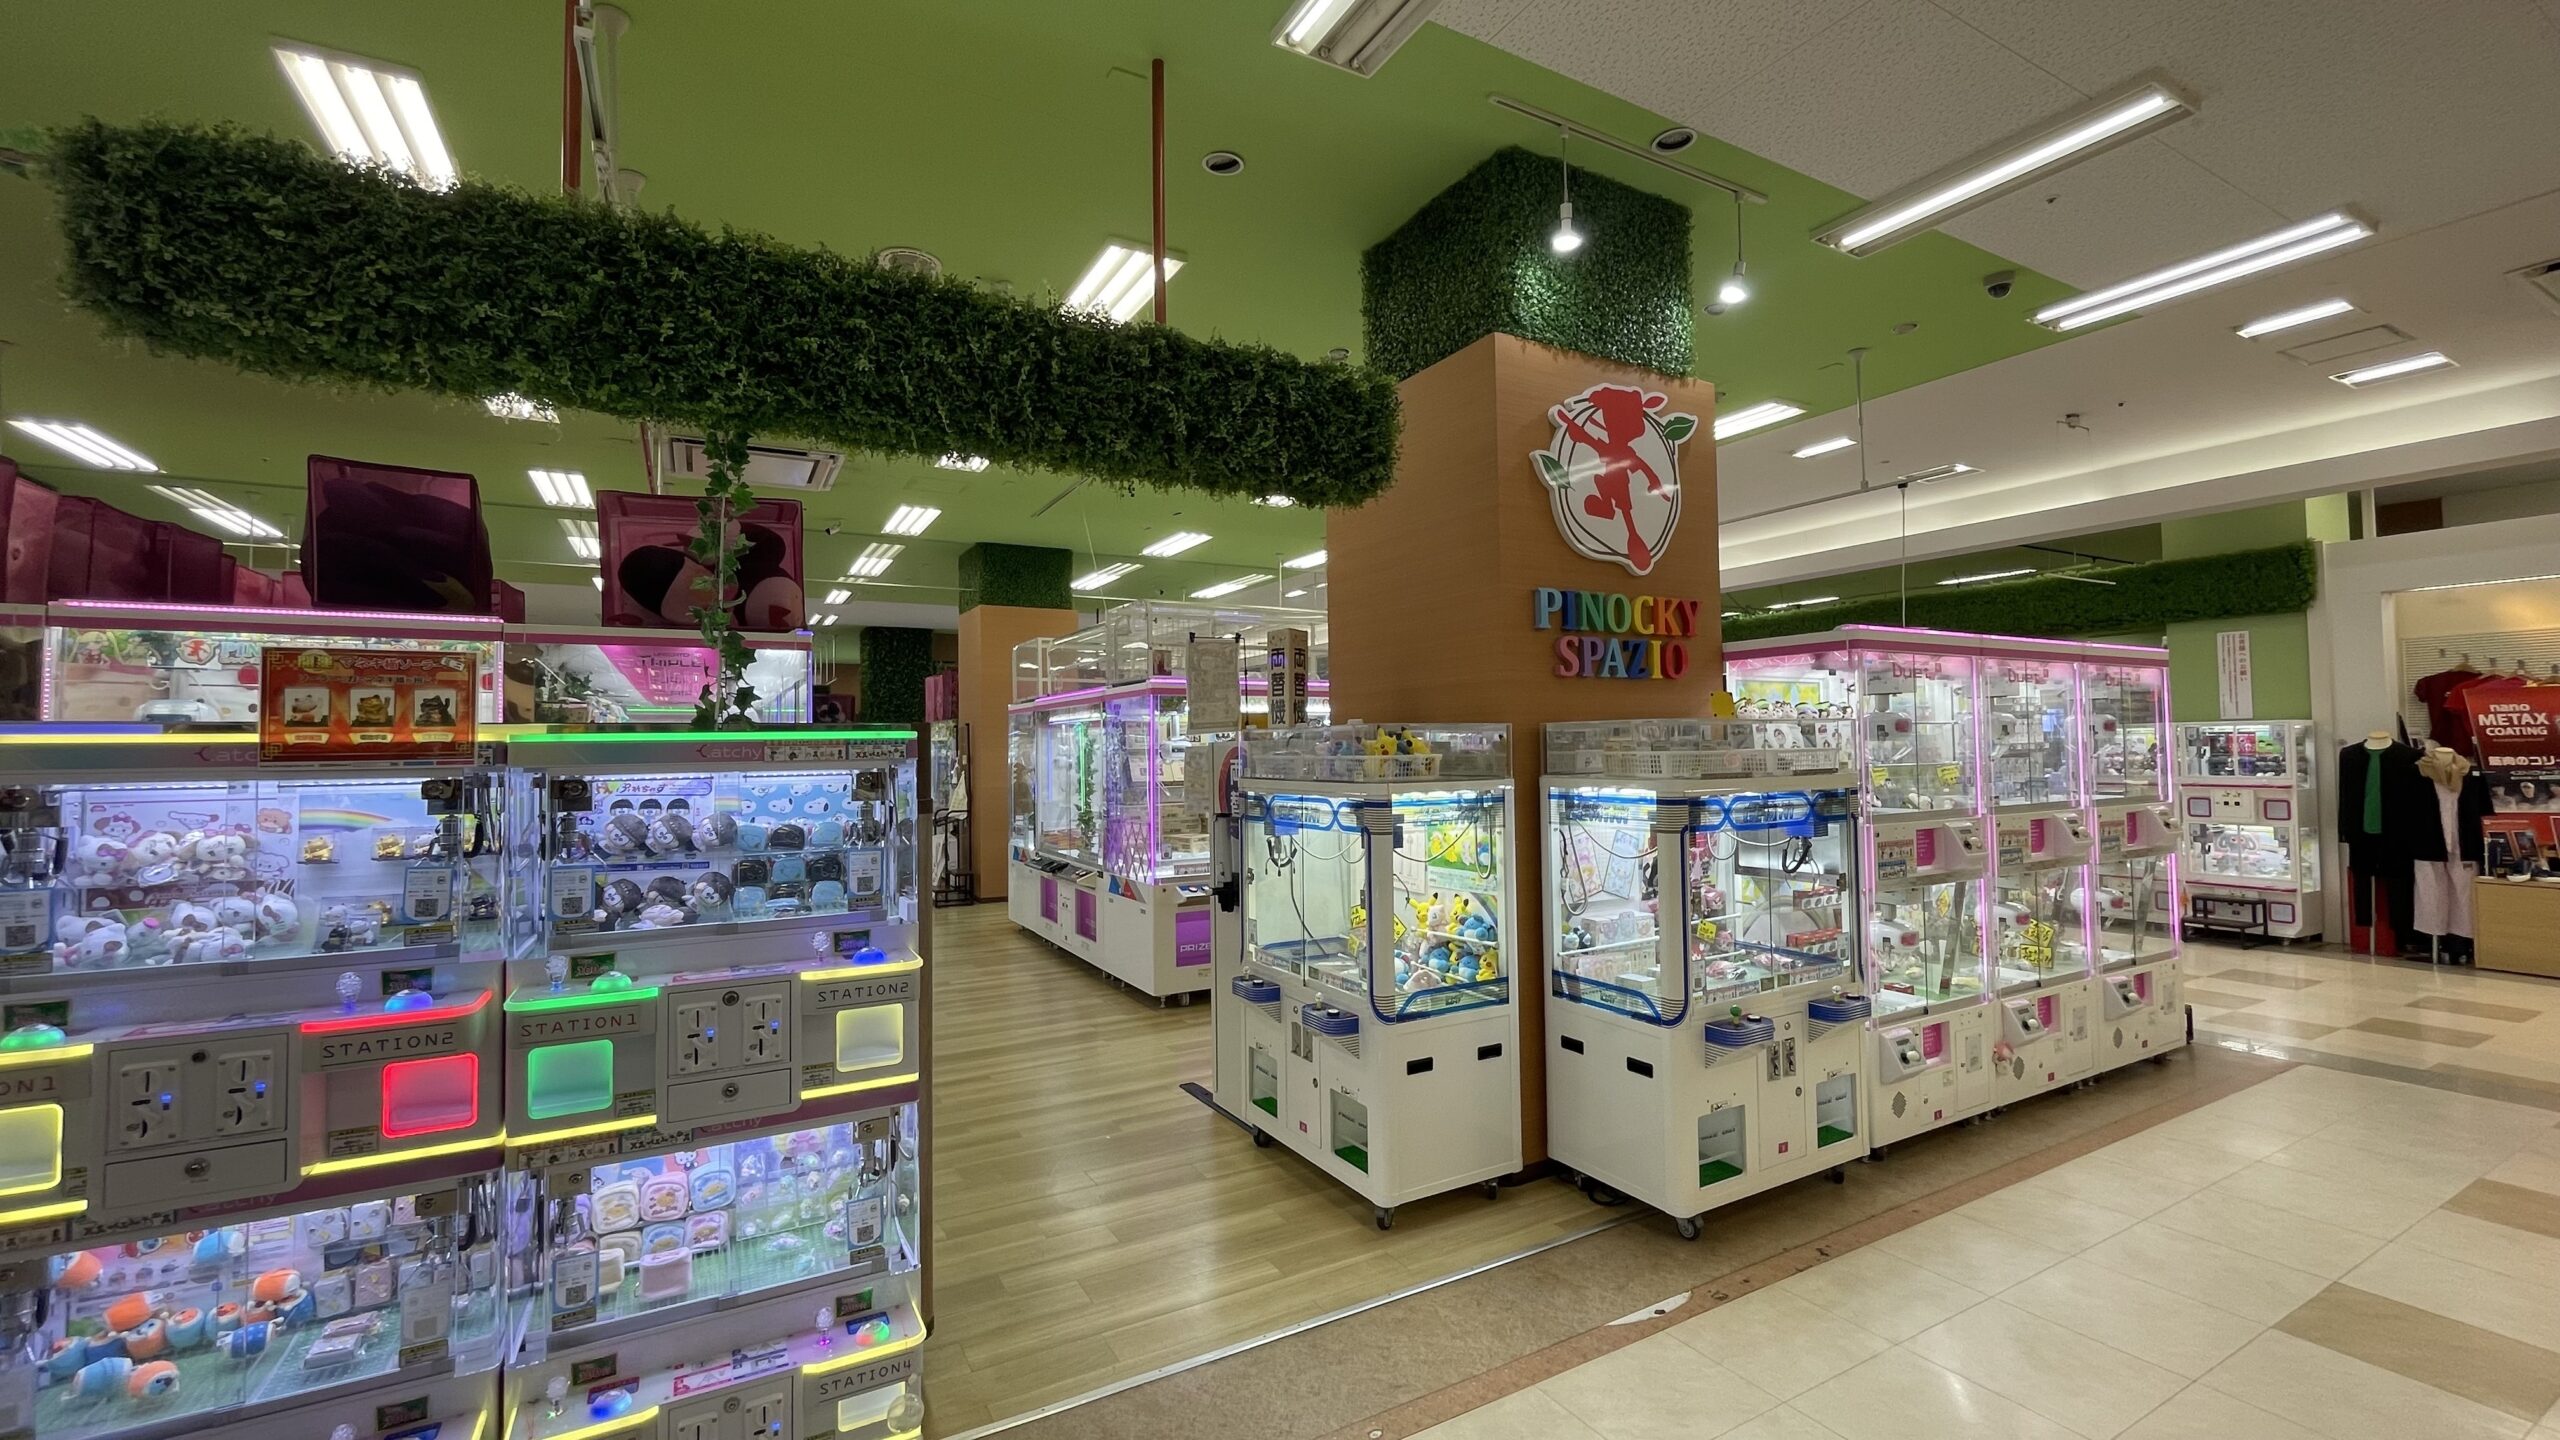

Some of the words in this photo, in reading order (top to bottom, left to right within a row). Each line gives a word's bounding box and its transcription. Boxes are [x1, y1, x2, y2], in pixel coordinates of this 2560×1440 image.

[1534, 588, 1702, 636] PINOCKY
[1556, 637, 1688, 679] SPAZIO
[1270, 647, 1286, 725] 両替機
[2478, 712, 2550, 726] METAX
[2489, 703, 2530, 712] nano
[2485, 726, 2548, 736] COATING
[695, 743, 762, 762] Catchy
[817, 981, 909, 1003] STATION2
[520, 1013, 637, 1038] STATION1
[321, 1031, 454, 1059] STATION2
[819, 1359, 912, 1396] STATION4
